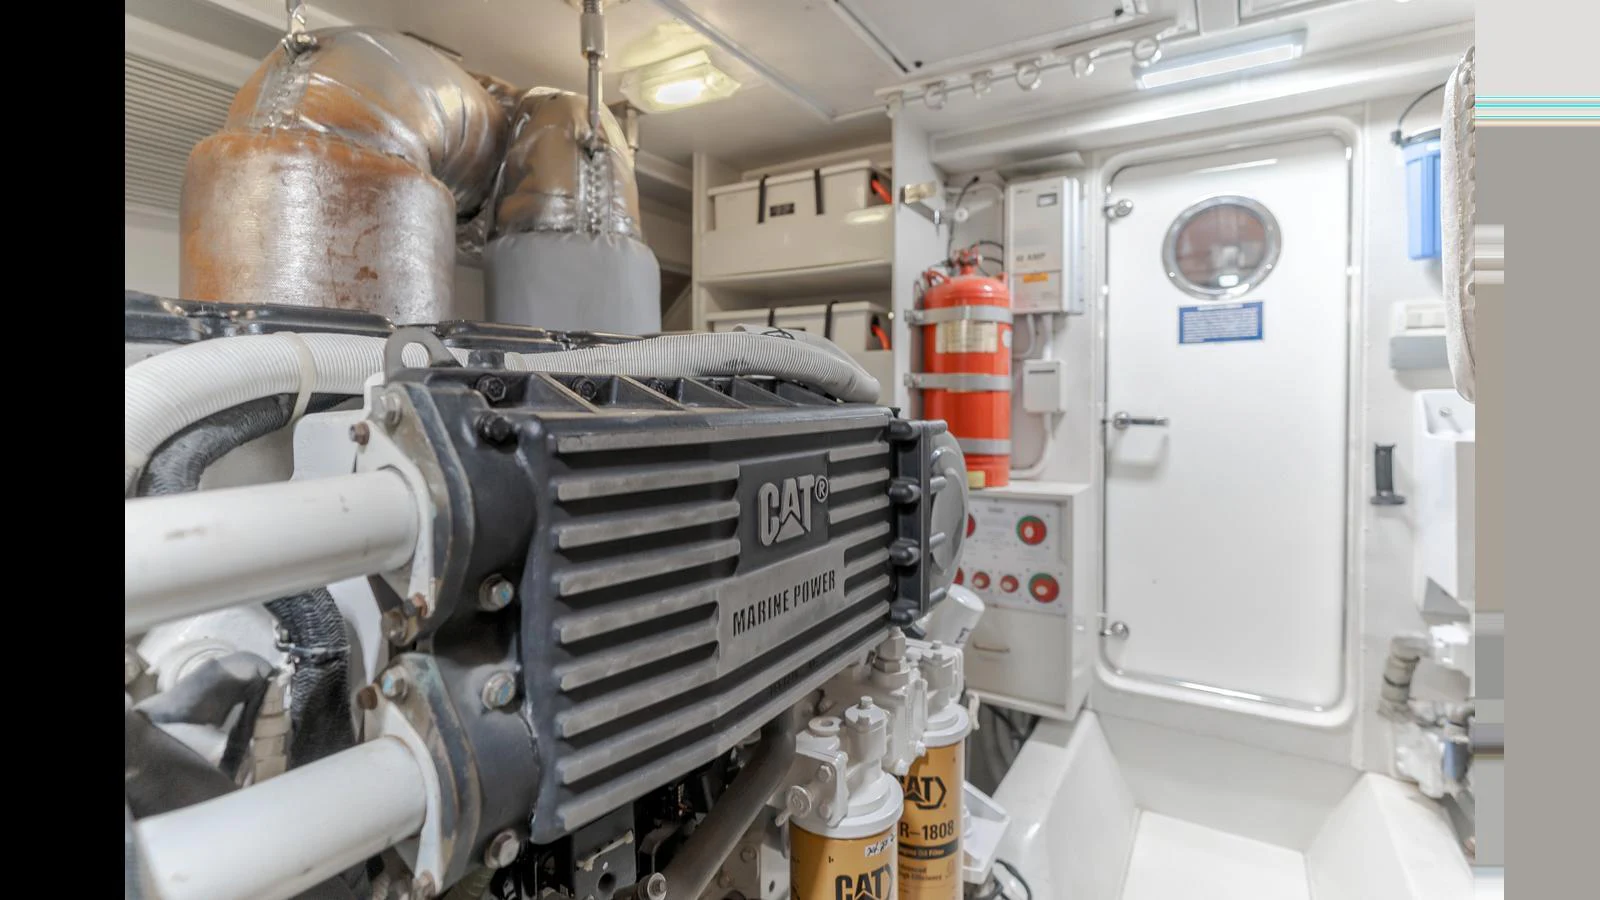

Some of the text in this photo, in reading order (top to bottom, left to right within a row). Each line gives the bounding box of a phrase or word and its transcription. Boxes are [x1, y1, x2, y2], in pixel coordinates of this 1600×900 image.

[732, 569, 836, 637] MARINE POWER
[835, 866, 883, 900] CAT
